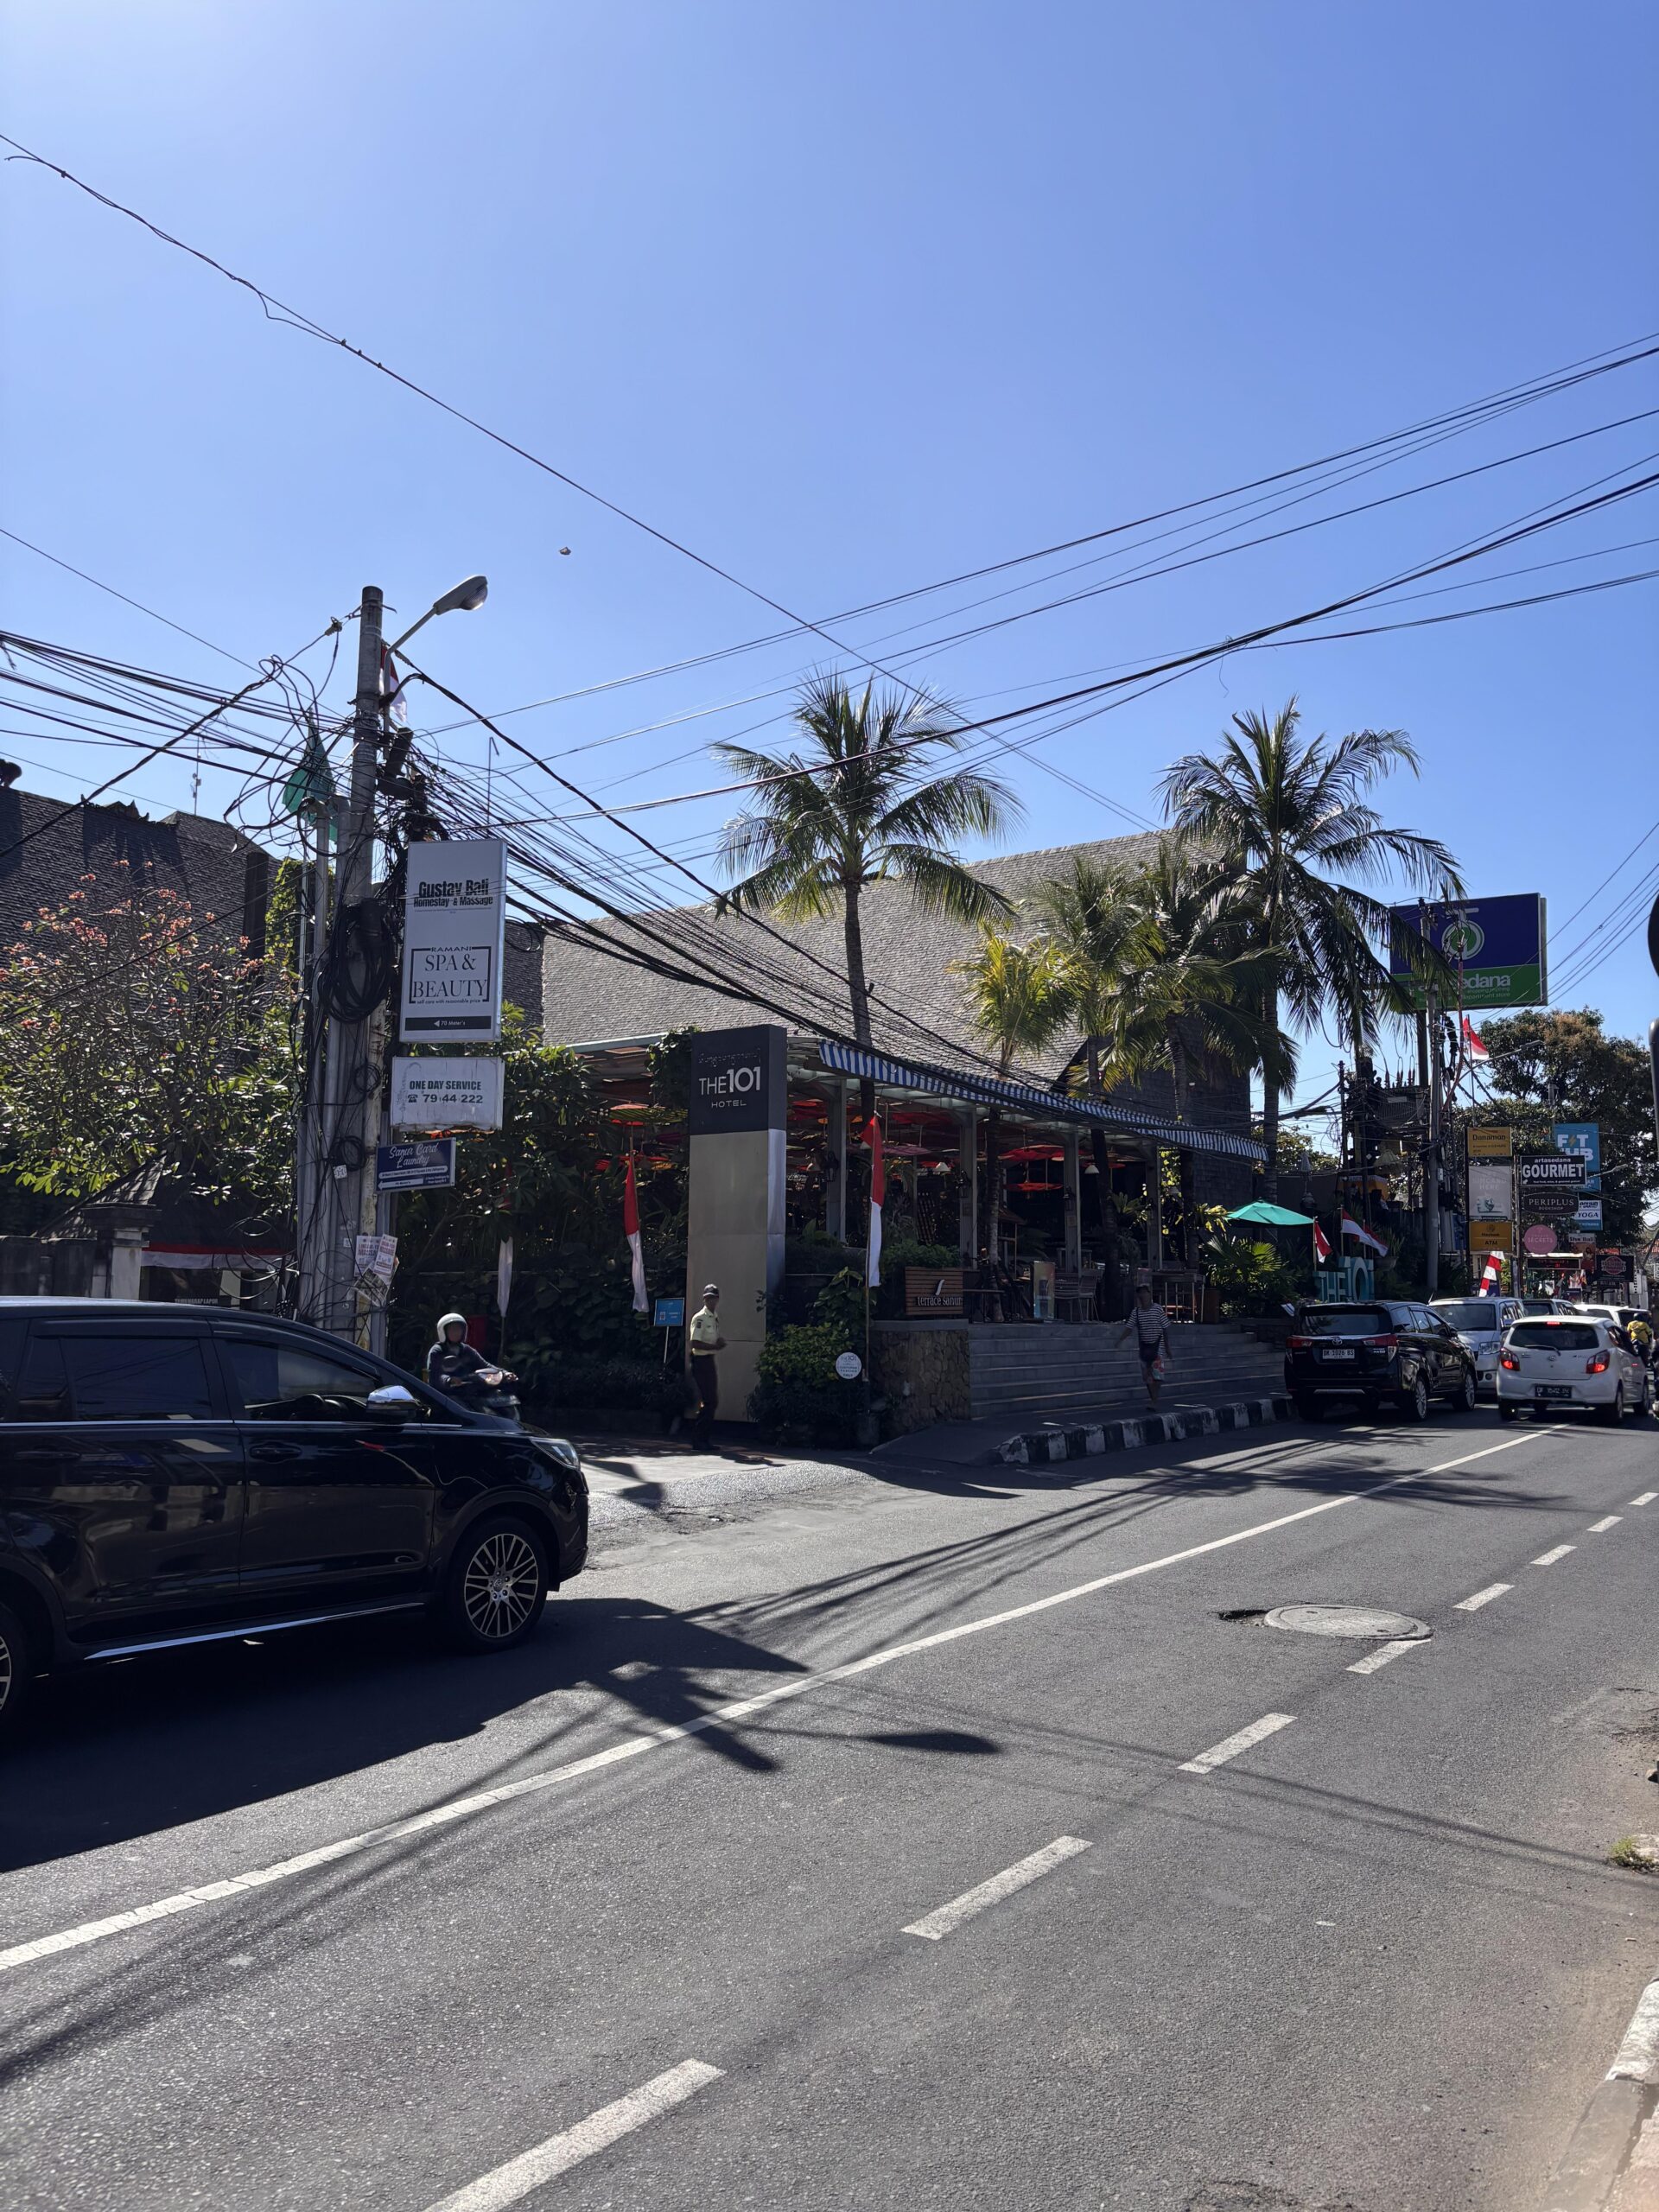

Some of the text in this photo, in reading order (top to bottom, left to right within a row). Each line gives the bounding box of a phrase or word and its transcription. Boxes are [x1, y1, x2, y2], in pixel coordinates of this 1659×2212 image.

[466, 878, 489, 896] Bali
[413, 896, 493, 907] Homestay & Massage
[425, 953, 478, 972] SPA &
[412, 979, 487, 998] BEAUTY
[409, 1080, 482, 1090] ONE DAY SERVICE
[698, 1066, 761, 1096] THE 101
[461, 1094, 484, 1104] 222
[711, 1099, 747, 1109] HOTEL
[1522, 1163, 1585, 1179] GOURMET
[1529, 1198, 1574, 1207] PERIPLUS
[1313, 1255, 1375, 1303] THE 101
[918, 1295, 963, 1306] terrace sanur
